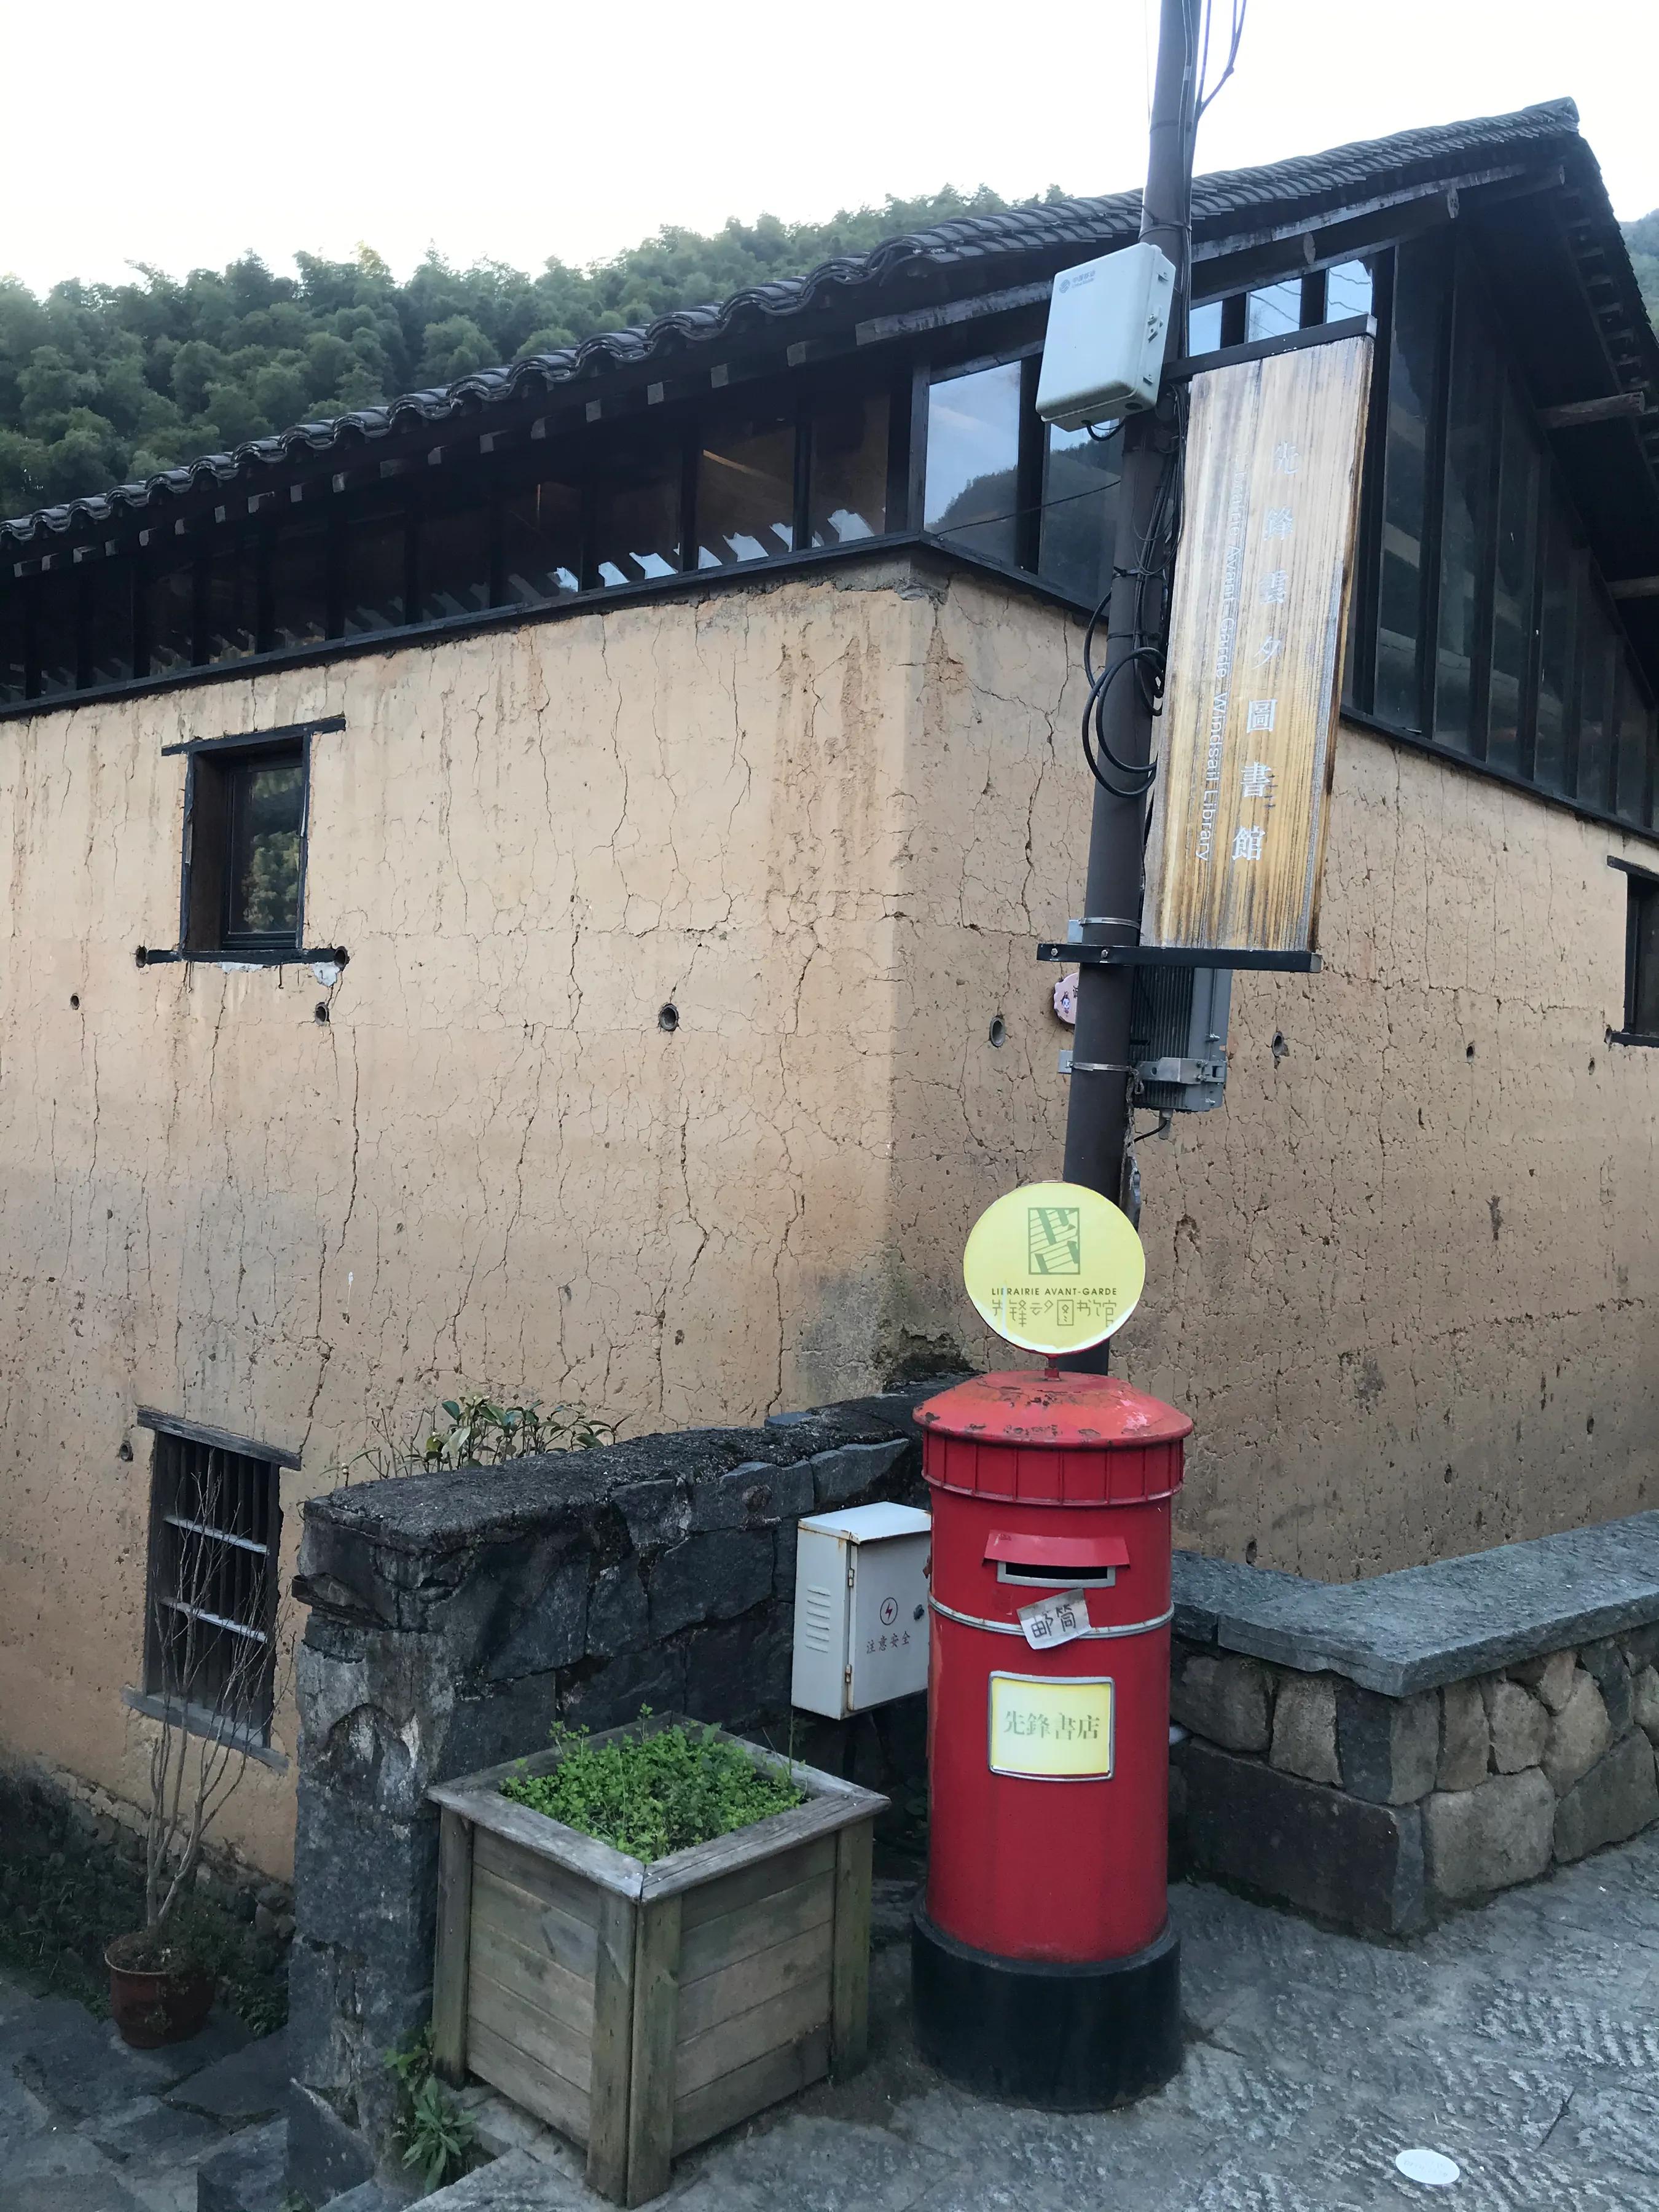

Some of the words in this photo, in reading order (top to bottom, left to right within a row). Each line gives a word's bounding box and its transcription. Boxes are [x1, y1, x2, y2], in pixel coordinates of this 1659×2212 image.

[1216, 544, 1241, 678] Avant-Garde
[1206, 689, 1230, 781] Windsail
[1196, 790, 1218, 861] Library
[1045, 1287, 1117, 1296] AVANT-GARDE
[866, 1630, 911, 1655] 注意安全
[1030, 1604, 1077, 1639] 邮筒
